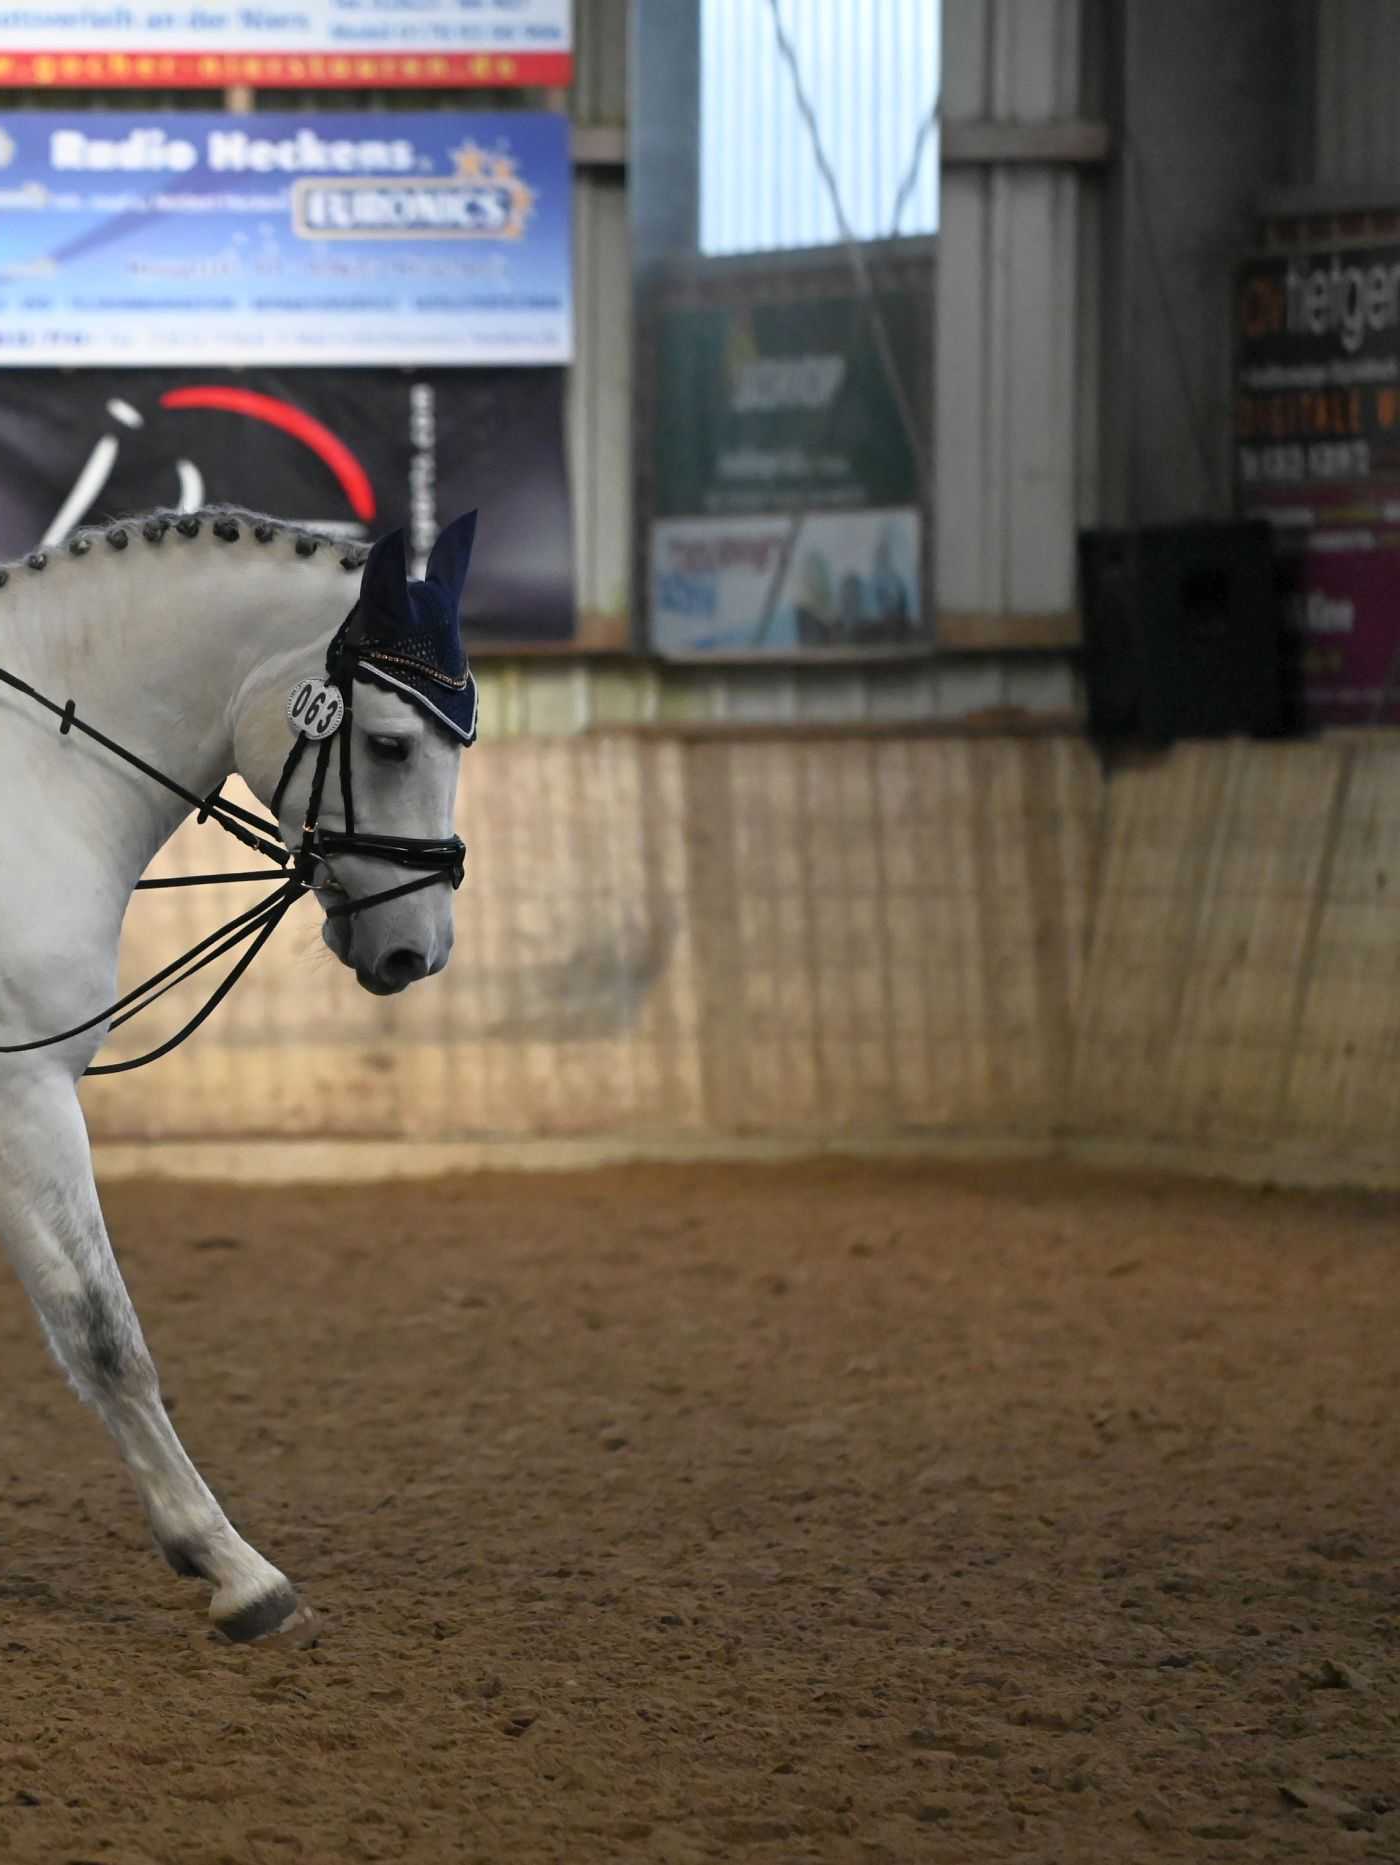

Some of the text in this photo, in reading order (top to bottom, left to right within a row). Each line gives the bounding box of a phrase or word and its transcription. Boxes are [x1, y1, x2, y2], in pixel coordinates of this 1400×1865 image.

[49, 128, 197, 172] Radio
[307, 186, 507, 228] EURONICS
[292, 684, 338, 733] 063
